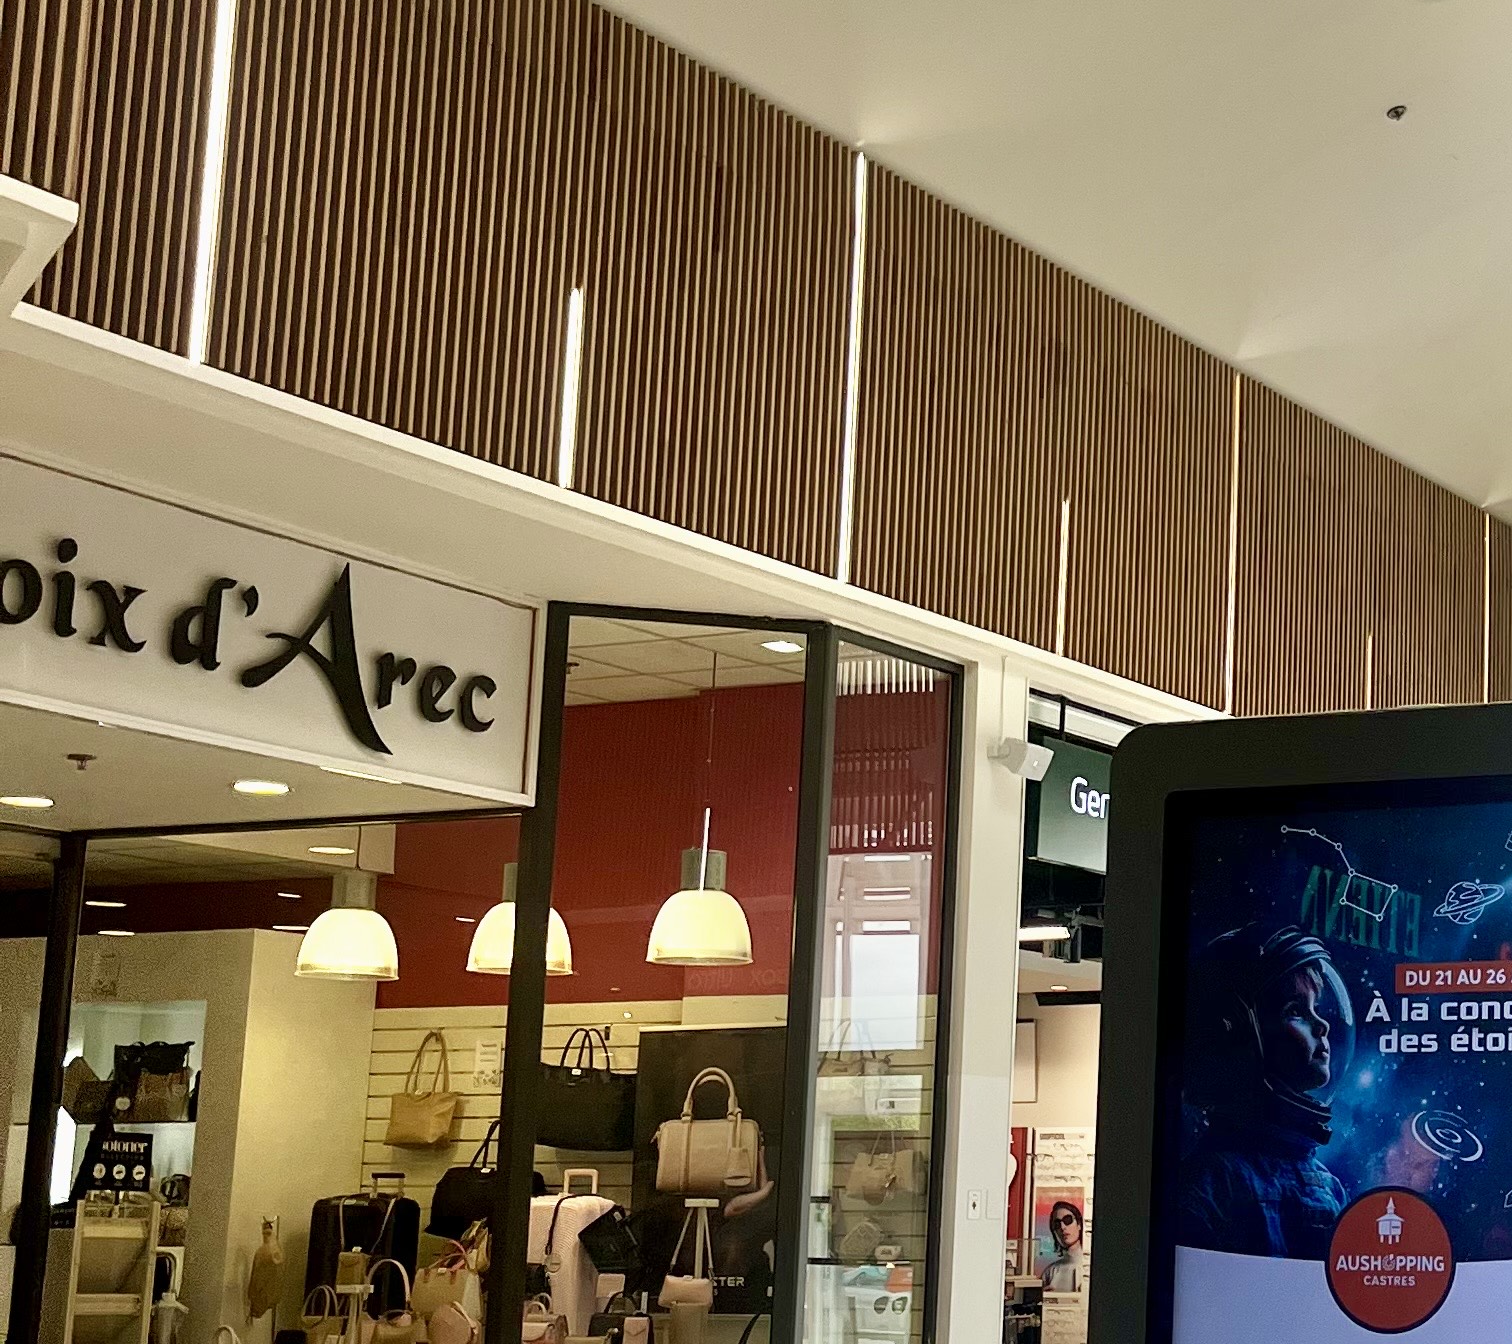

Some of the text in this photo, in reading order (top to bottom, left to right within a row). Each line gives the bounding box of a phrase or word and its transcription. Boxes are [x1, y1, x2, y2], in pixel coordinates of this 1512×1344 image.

[168, 561, 498, 756] d'Arec
[1405, 969, 1431, 987] DU
[1435, 970, 1452, 986] 21
[1457, 968, 1481, 985] AU
[1486, 968, 1505, 985] 26
[1365, 990, 1391, 1022] À
[1401, 997, 1429, 1022] la
[1379, 1028, 1438, 1053] des
[1335, 1253, 1445, 1273] AUSHOPPING
[1363, 1274, 1416, 1288] CASTRES
